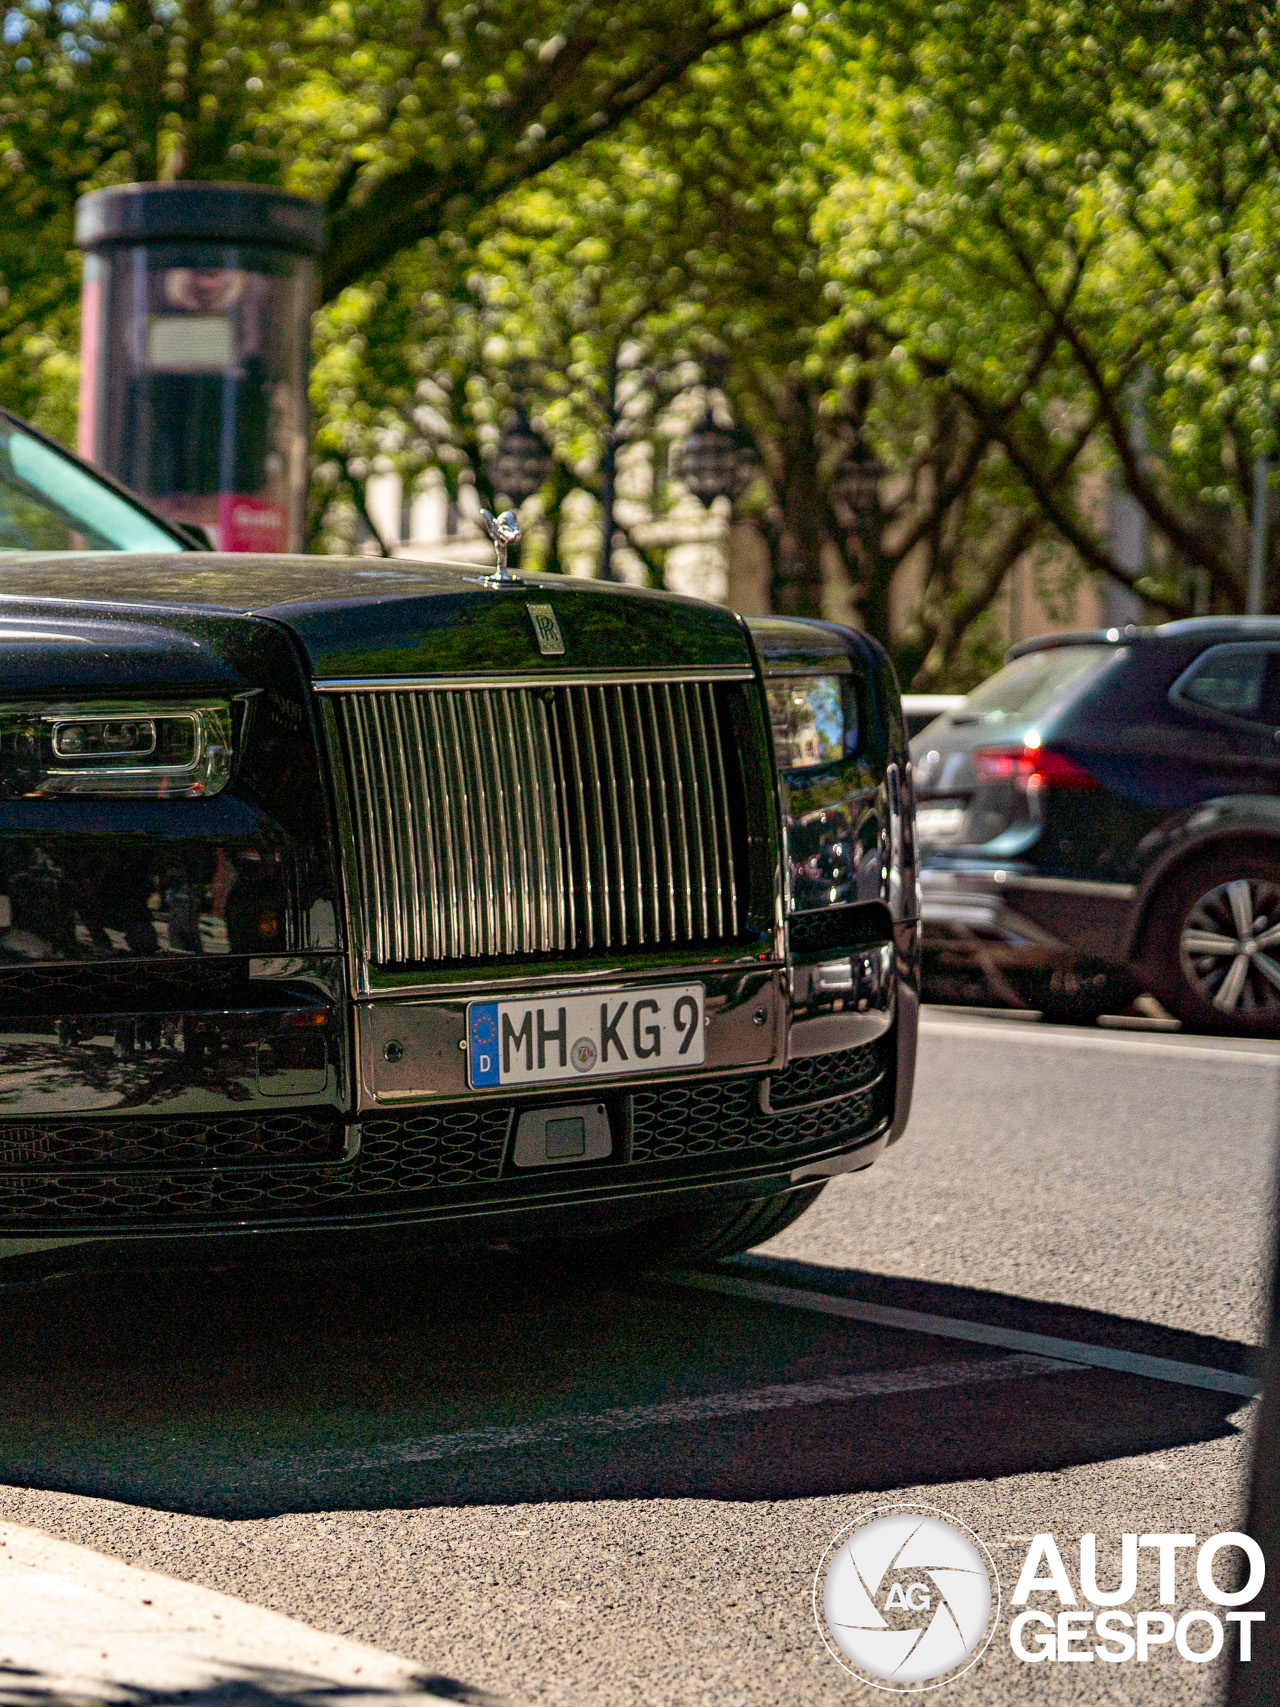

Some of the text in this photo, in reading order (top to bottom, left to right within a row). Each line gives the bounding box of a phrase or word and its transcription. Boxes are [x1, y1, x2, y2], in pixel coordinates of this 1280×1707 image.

[501, 1006, 568, 1073] MH
[600, 999, 662, 1063] KG
[672, 994, 700, 1055] 9
[479, 1055, 491, 1073] D
